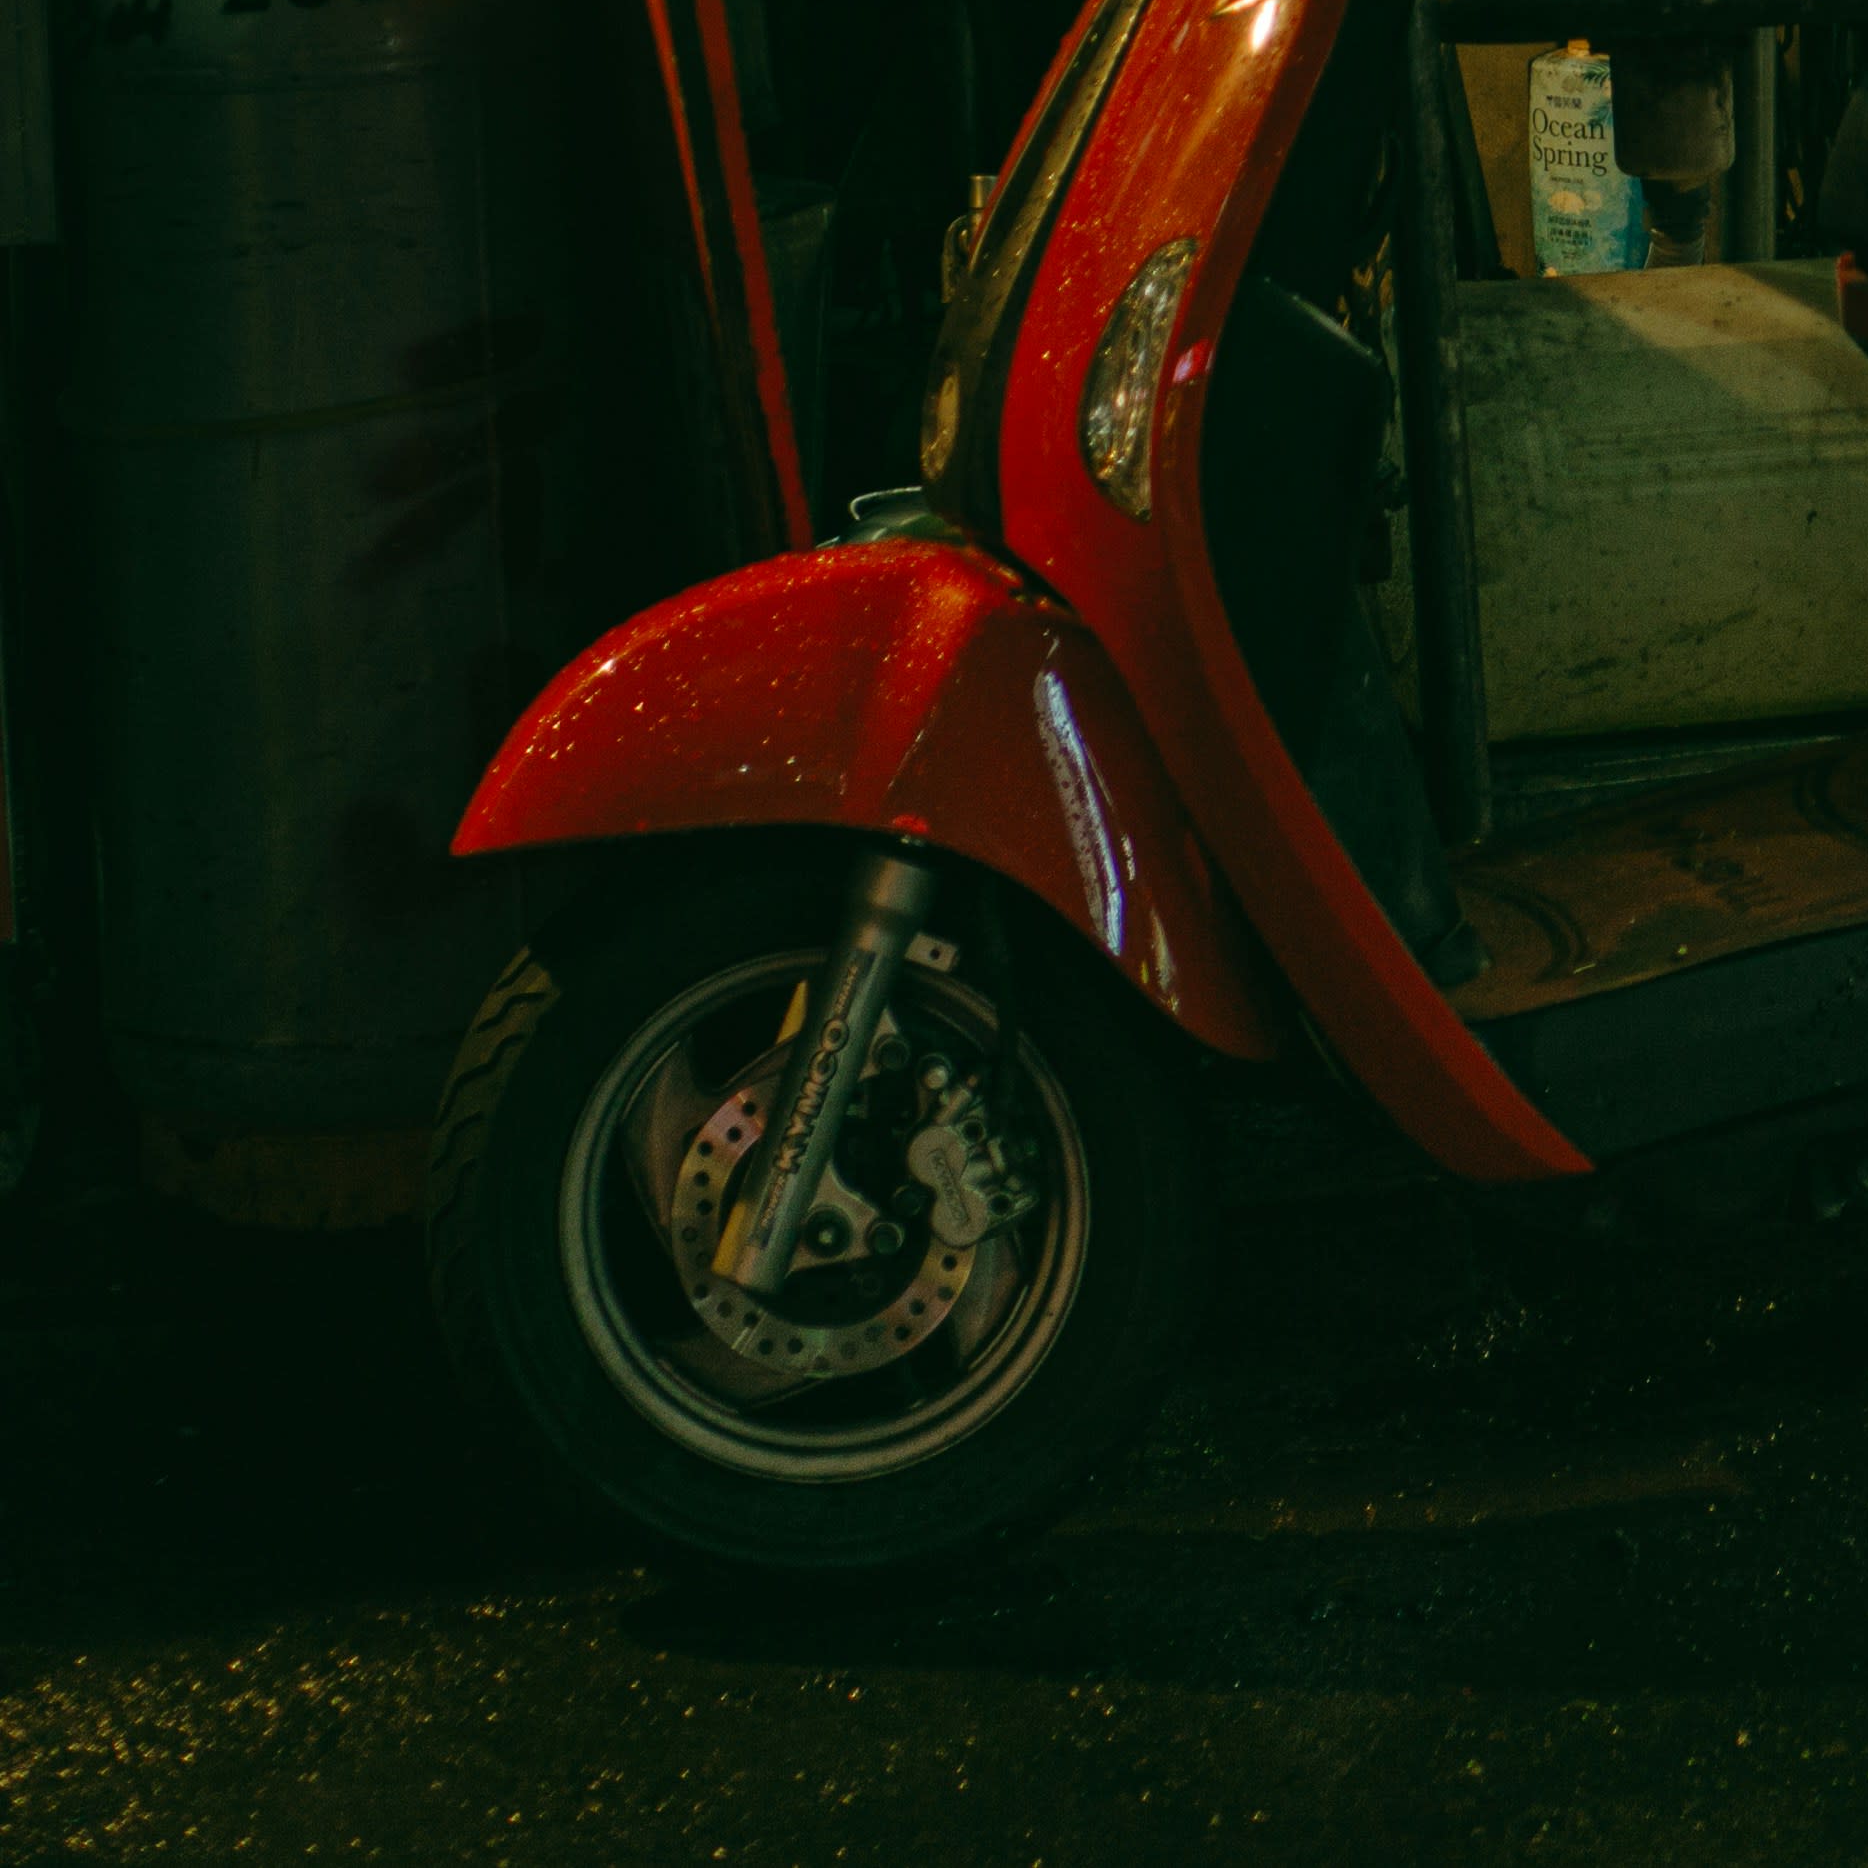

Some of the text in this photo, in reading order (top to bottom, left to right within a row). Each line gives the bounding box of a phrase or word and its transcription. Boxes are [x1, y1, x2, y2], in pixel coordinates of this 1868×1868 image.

[1532, 107, 1606, 140] Ocean
[1532, 135, 1608, 177] Spring
[773, 1018, 850, 1173] KYMCO
